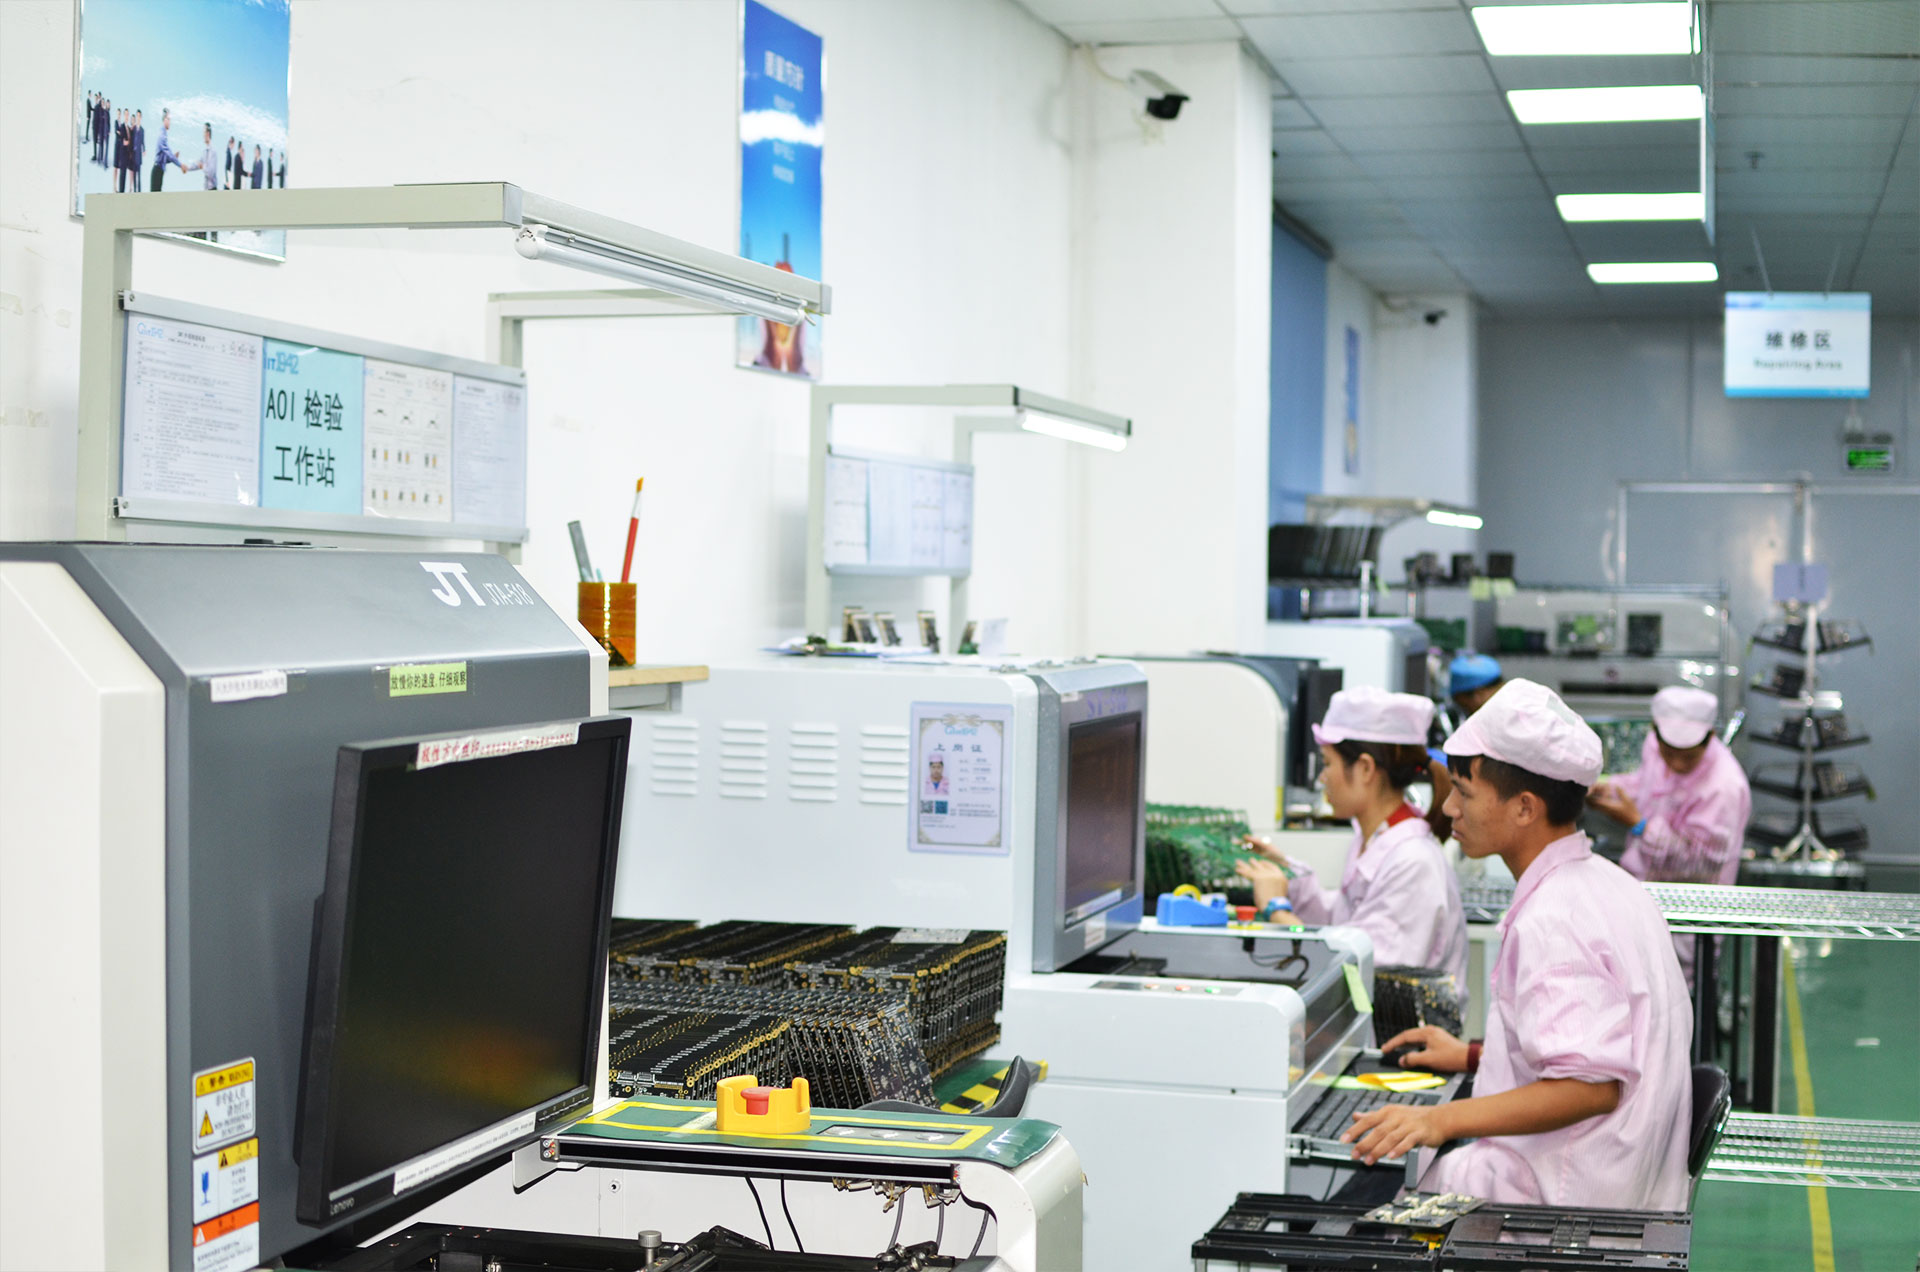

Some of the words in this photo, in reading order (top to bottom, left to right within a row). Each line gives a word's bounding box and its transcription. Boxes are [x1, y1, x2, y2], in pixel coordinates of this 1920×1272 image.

[1766, 331, 1831, 349] 维修区
[266, 387, 295, 422] AOI
[303, 388, 344, 431] 检验
[273, 445, 336, 488] 工作站
[419, 561, 487, 607] JT
